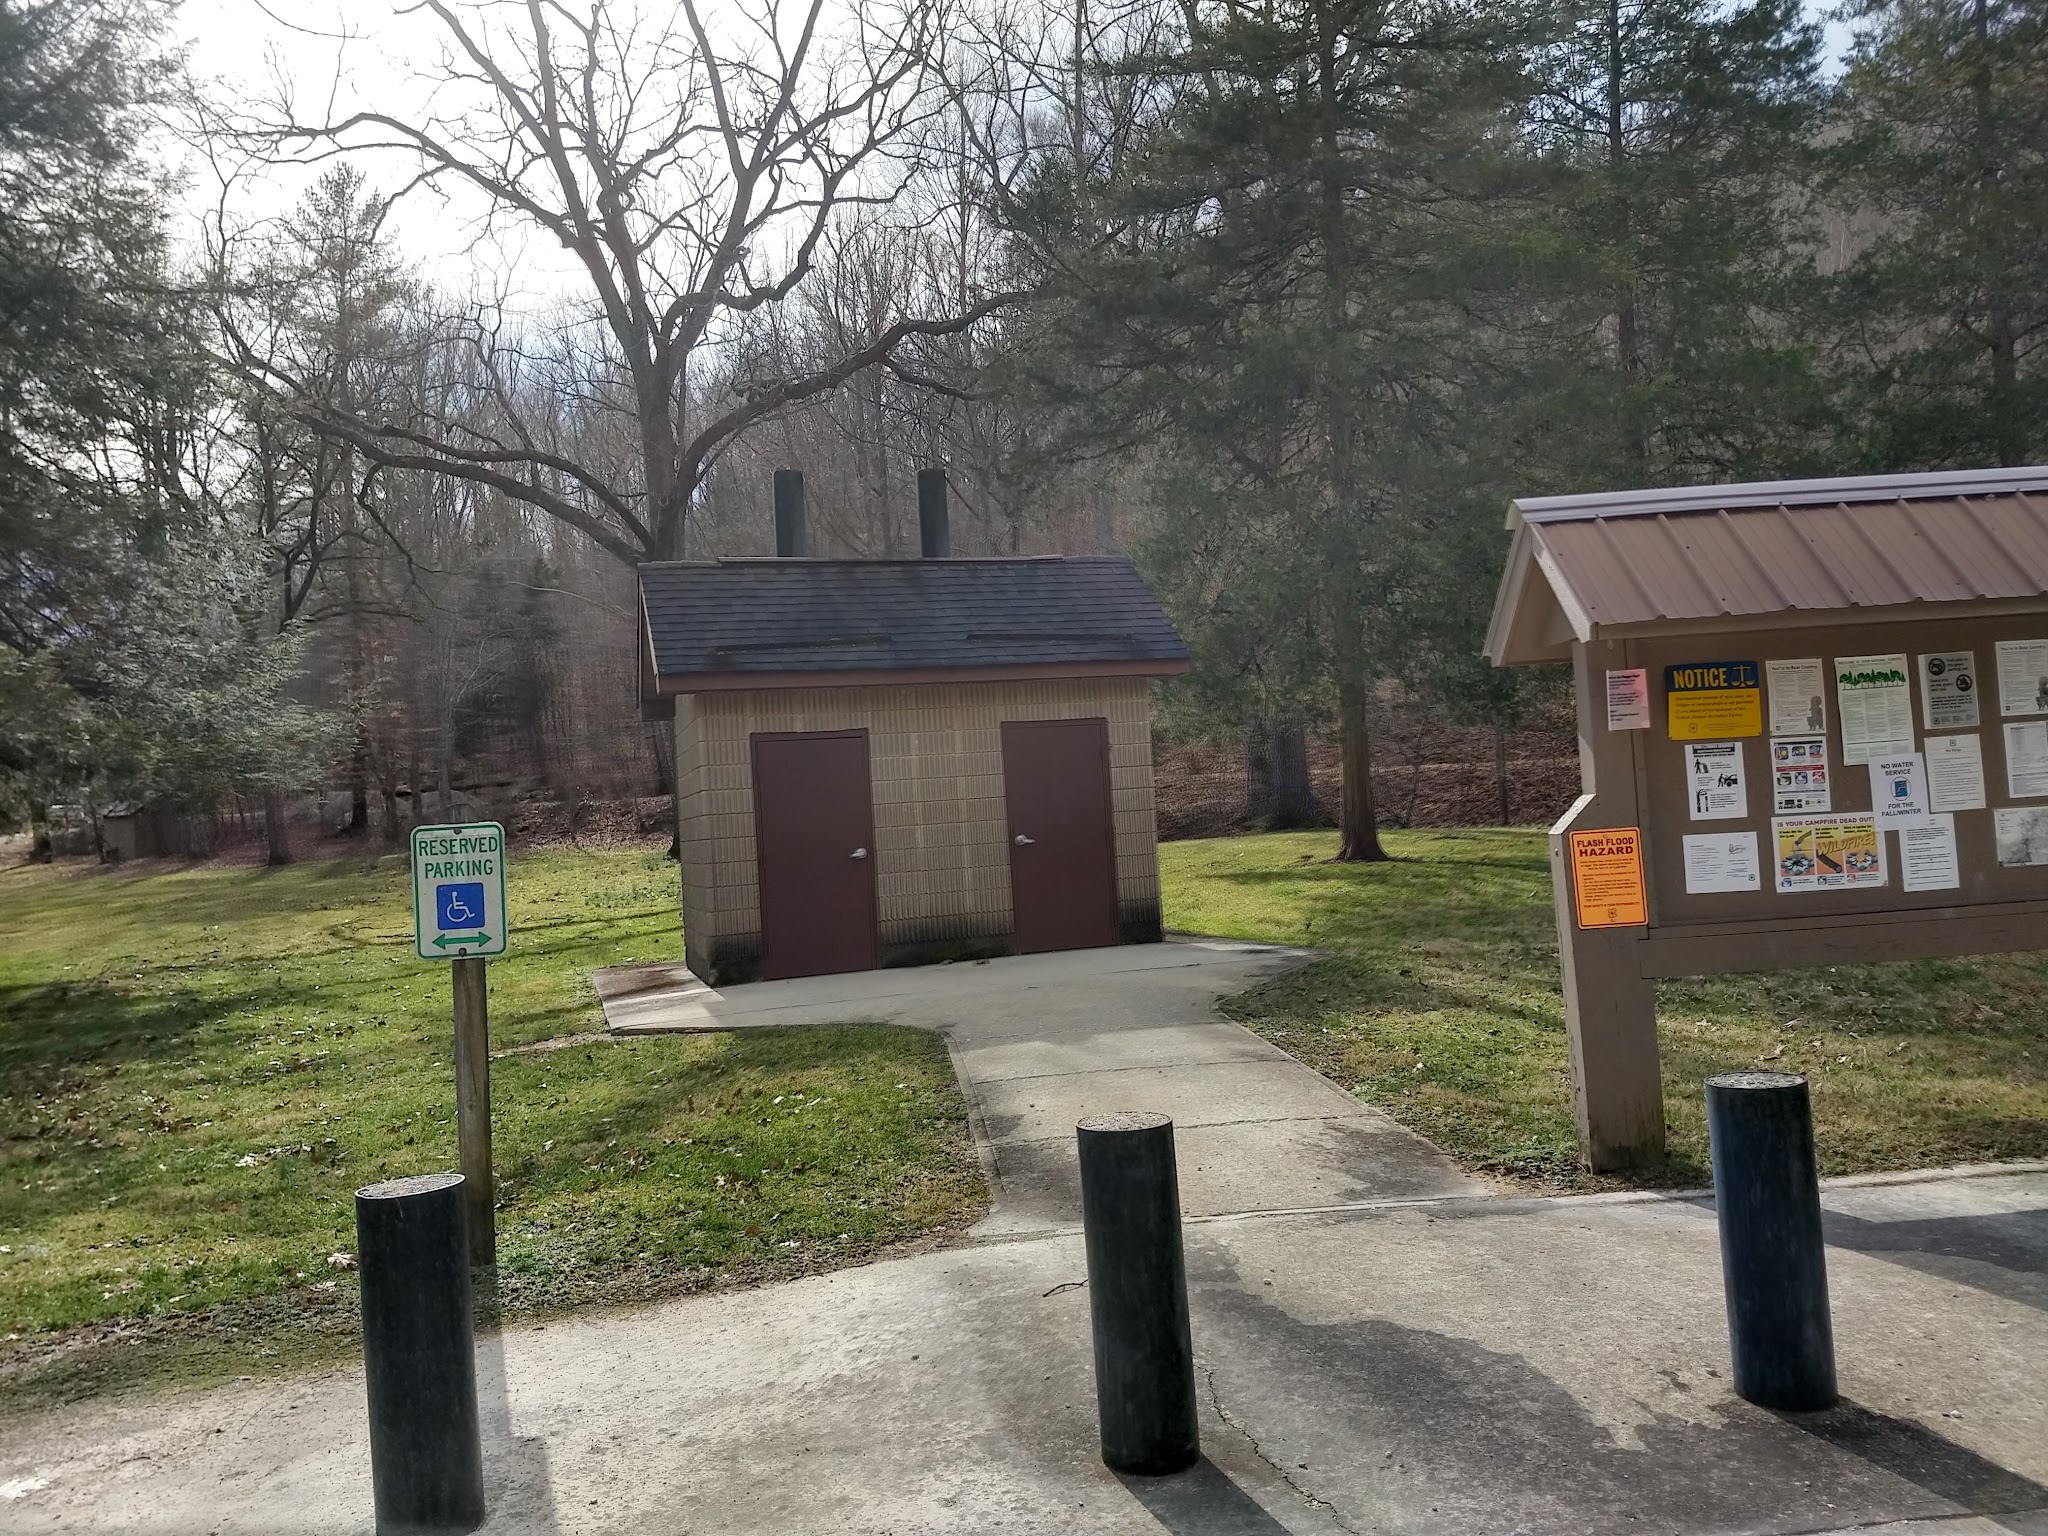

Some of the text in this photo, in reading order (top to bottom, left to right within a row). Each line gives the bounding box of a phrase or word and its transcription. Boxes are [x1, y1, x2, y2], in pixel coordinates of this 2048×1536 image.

[1673, 668, 1728, 689] NOTICE
[418, 836, 498, 856] RESERVED
[1577, 837, 1634, 848] FLASH FLOOD
[1580, 846, 1633, 857] HAZARD
[1817, 832, 1876, 856] WILDFIRE!
[424, 859, 494, 879] PARKING
